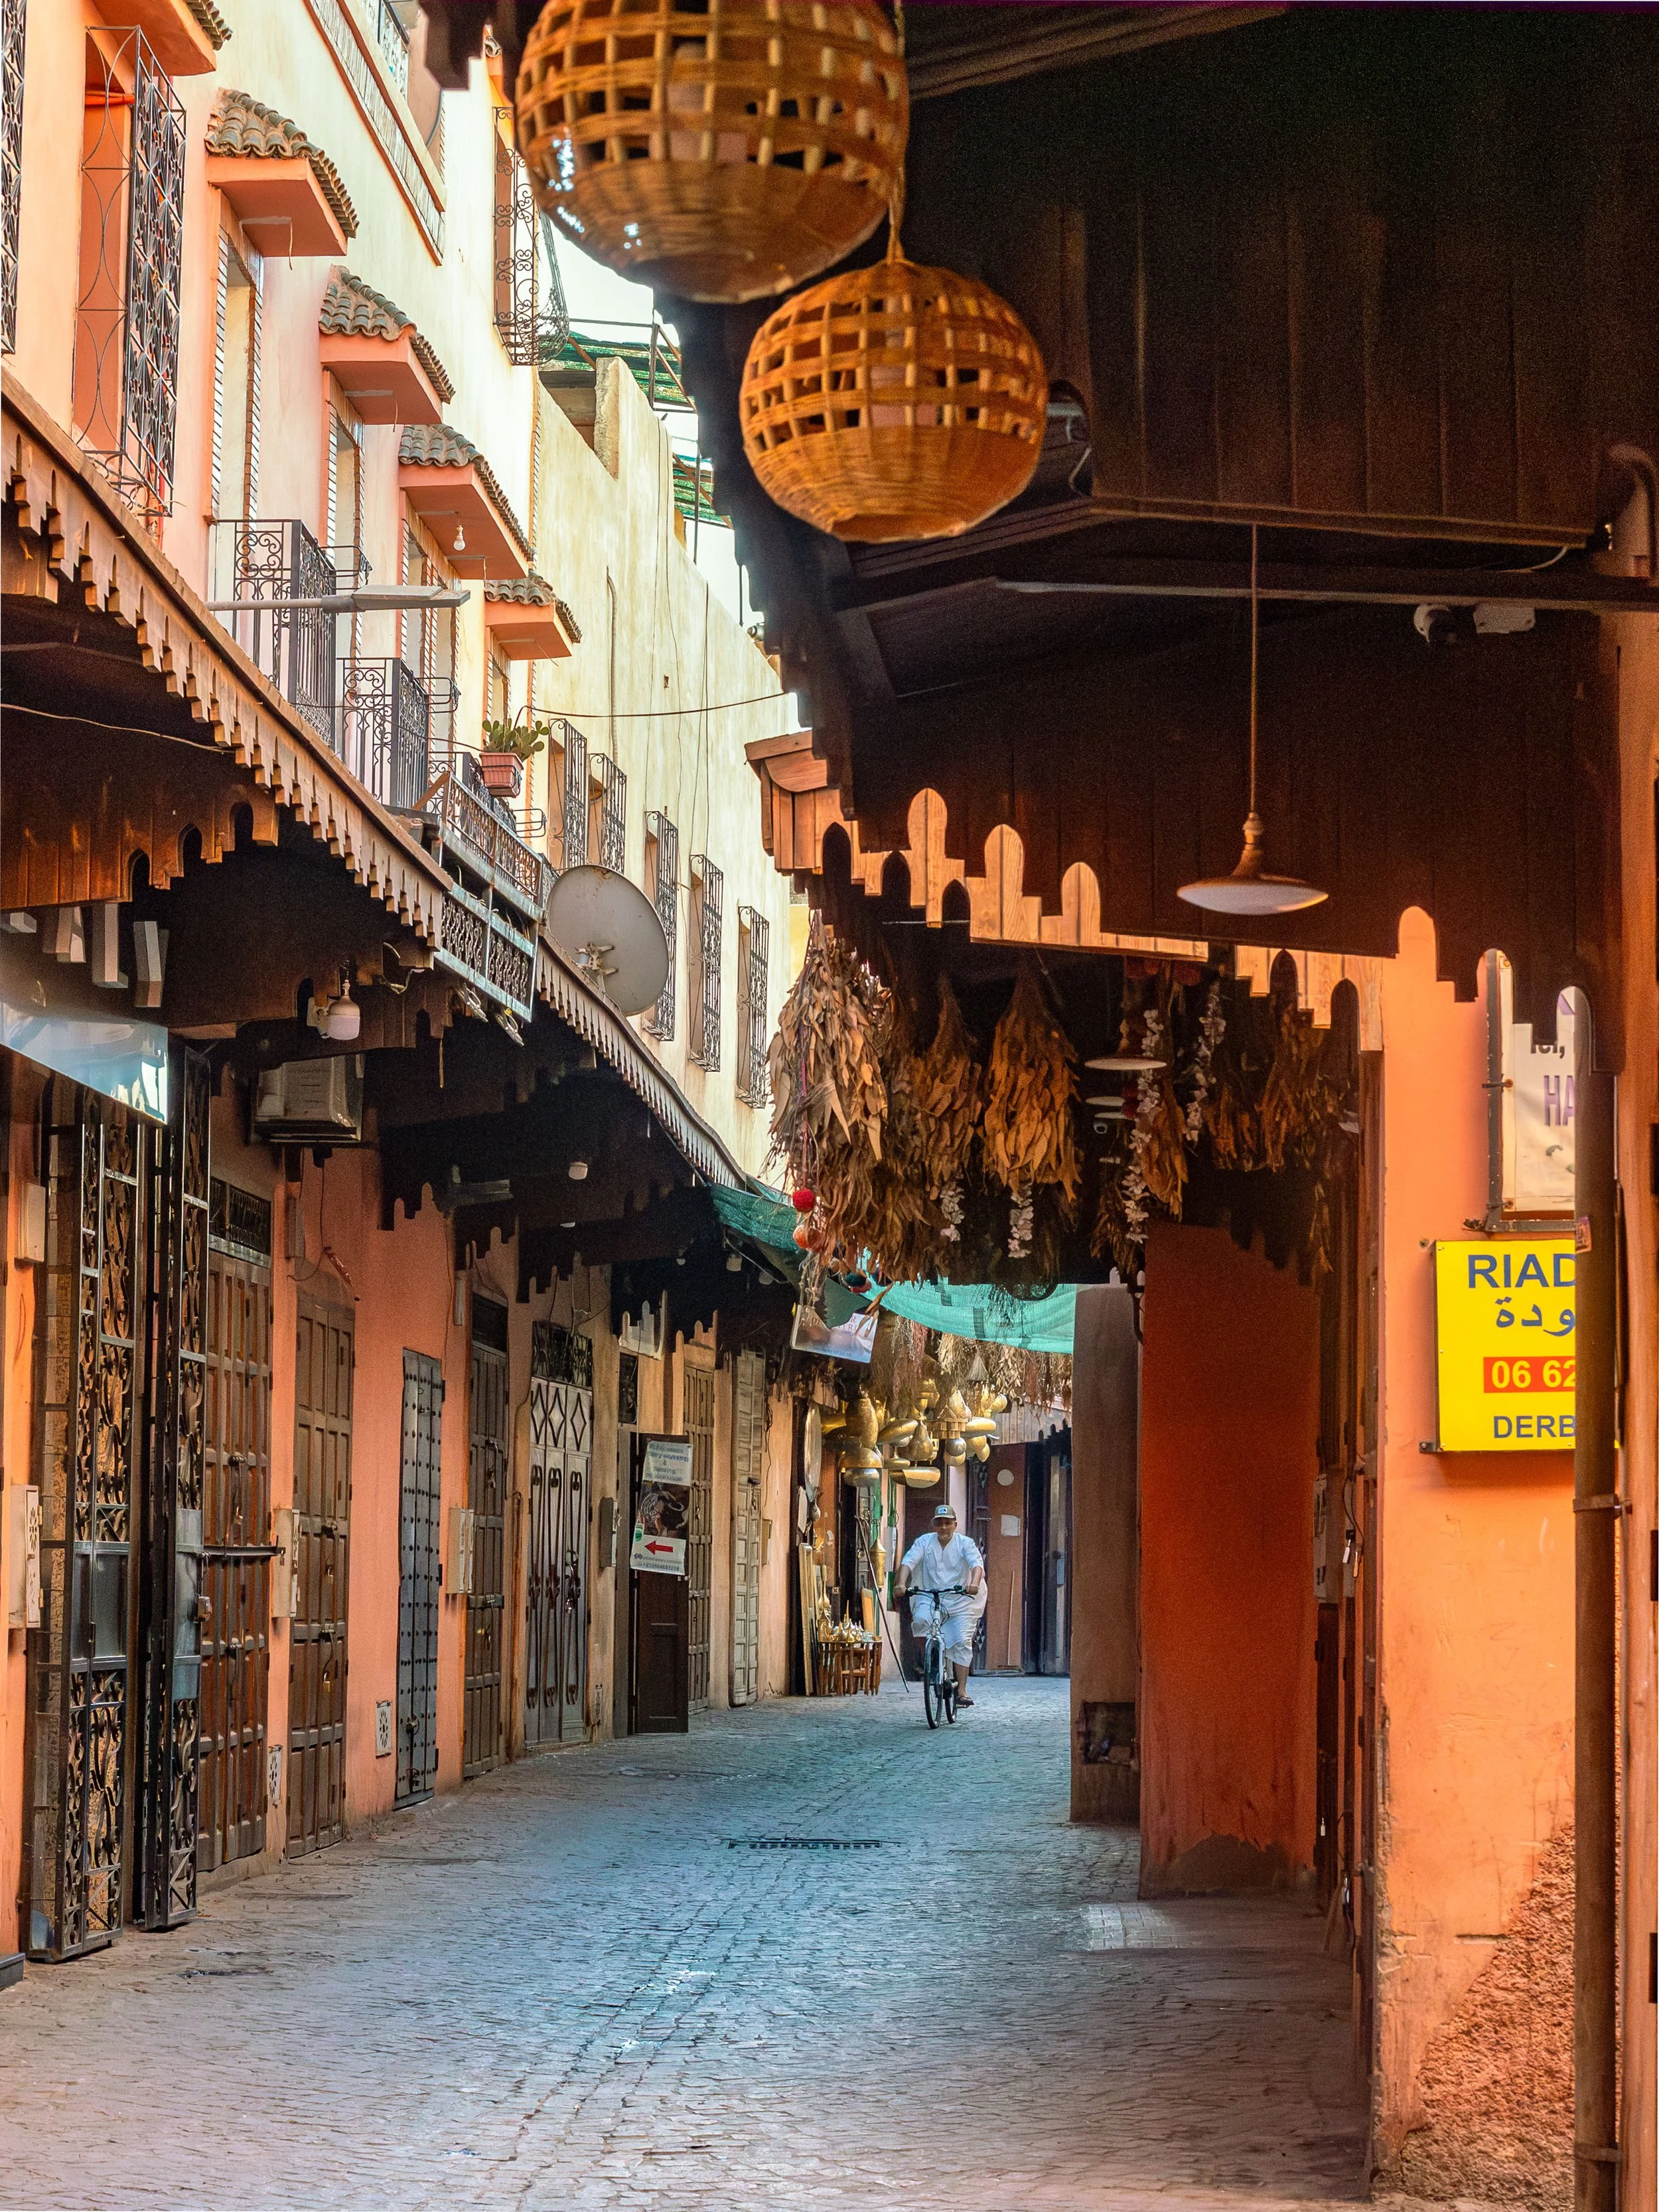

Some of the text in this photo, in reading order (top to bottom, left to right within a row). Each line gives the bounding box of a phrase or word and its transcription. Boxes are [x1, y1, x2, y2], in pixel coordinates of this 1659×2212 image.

[1467, 1254, 1575, 1289] RIAD
[1491, 1360, 1575, 1388] 06 62
[1494, 1416, 1575, 1438] DERB
